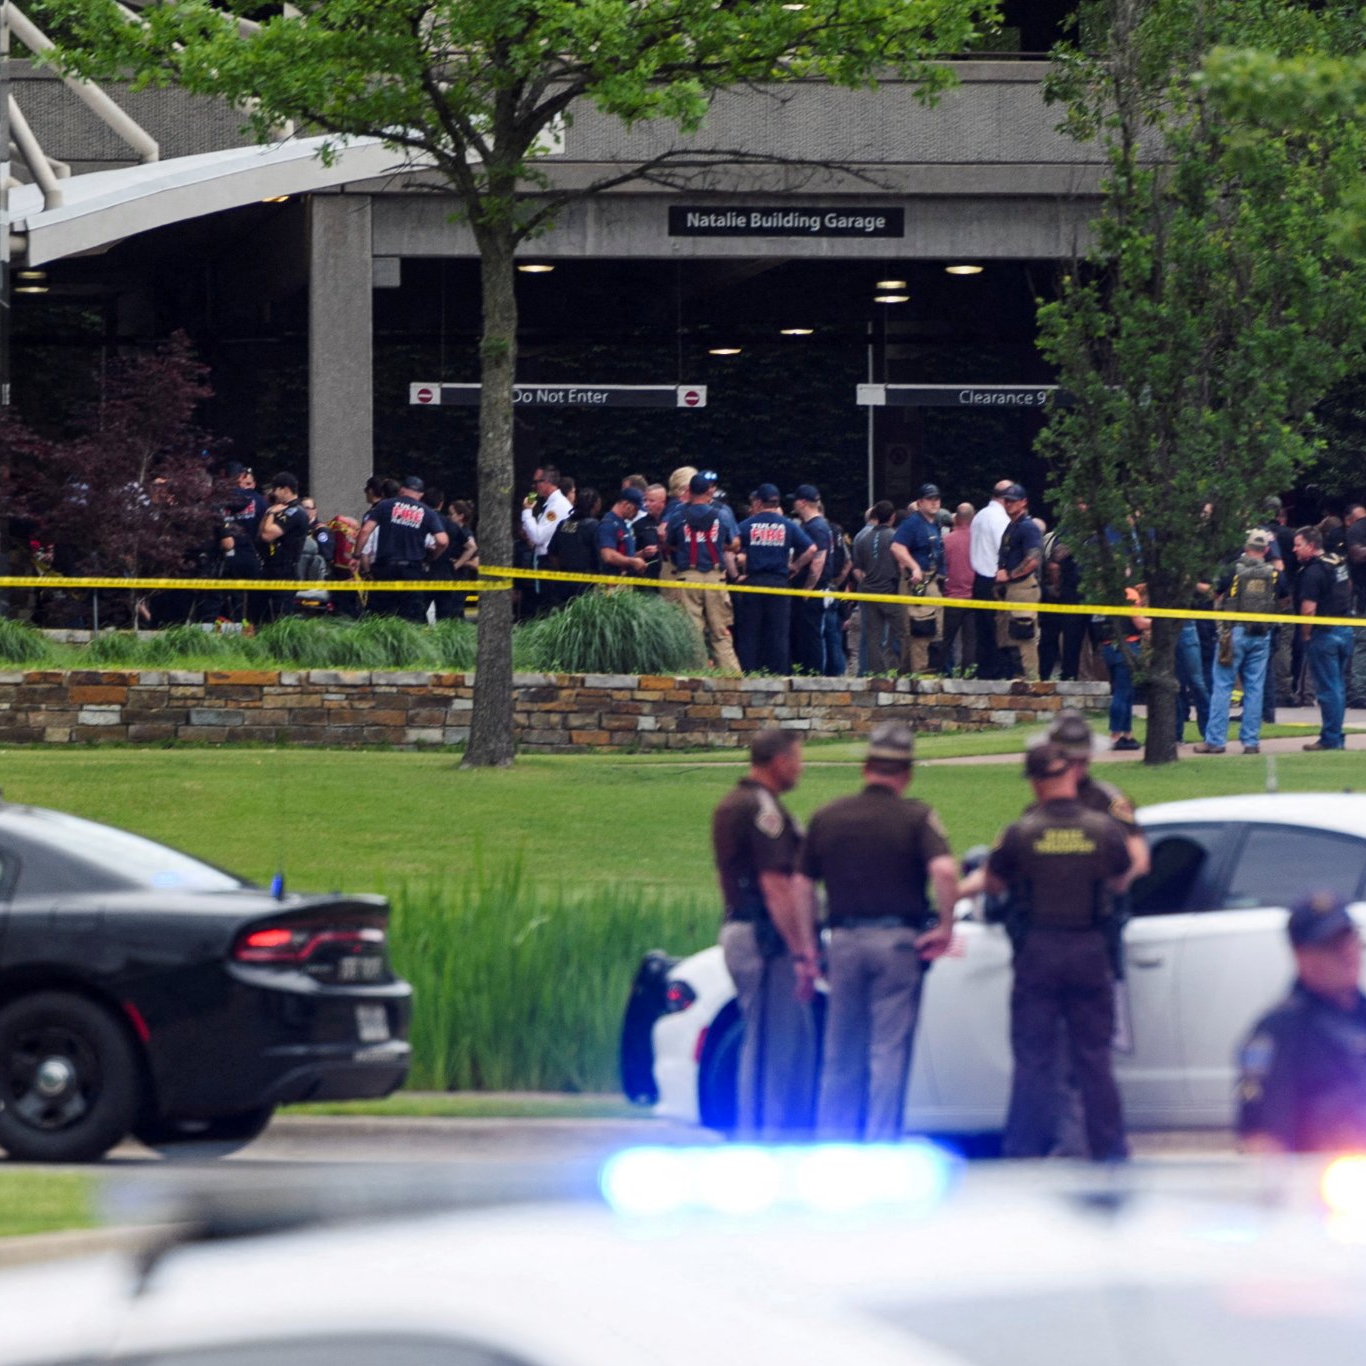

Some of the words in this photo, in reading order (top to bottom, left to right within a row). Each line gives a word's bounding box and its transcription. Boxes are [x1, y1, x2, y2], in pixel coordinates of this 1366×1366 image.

[686, 212, 747, 227] Natalie
[750, 213, 820, 231] Building
[824, 213, 885, 231] Garage
[512, 389, 533, 403] Do
[536, 389, 564, 403] Not
[568, 389, 609, 404] Enter
[959, 390, 1033, 405] Clearance
[392, 506, 424, 523] FIRE
[750, 528, 786, 541] FIRE
